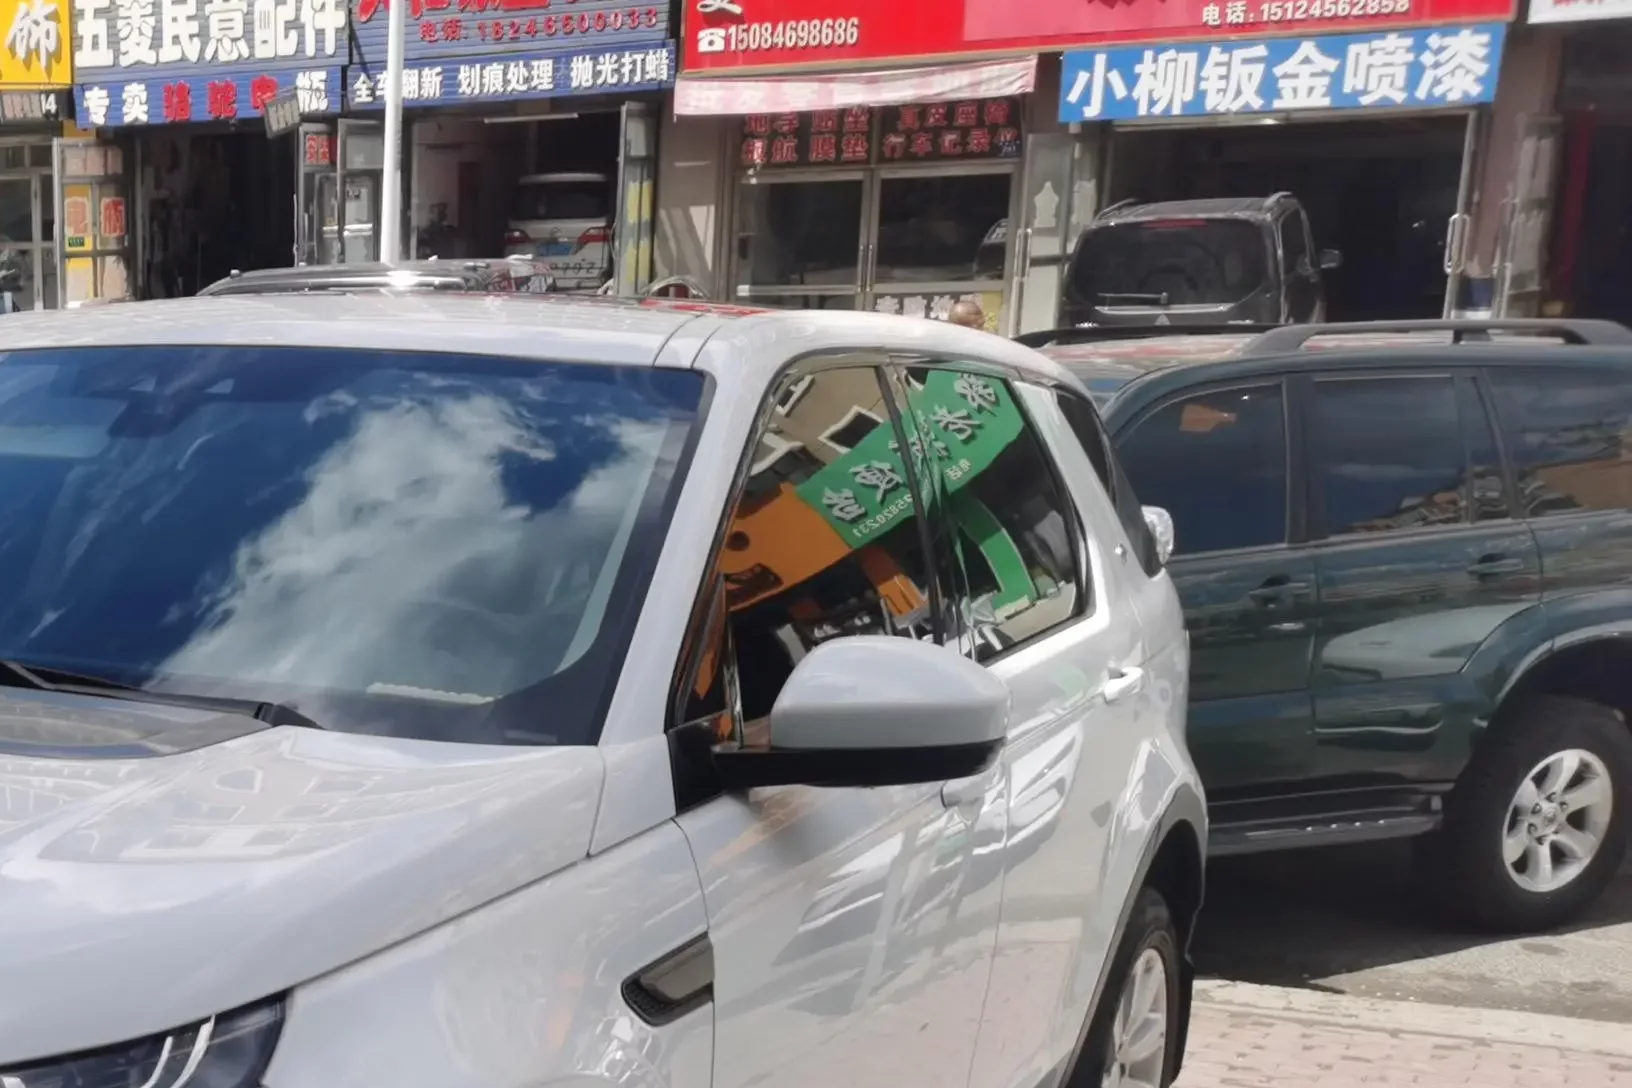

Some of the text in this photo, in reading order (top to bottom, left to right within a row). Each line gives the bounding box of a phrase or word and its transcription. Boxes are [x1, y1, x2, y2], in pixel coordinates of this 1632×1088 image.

[75, 0, 346, 68] 五菱民意配件
[727, 18, 859, 50] 15084698686
[457, 59, 555, 95] 划痕处理
[570, 48, 670, 88] 抛光打蜡
[1067, 30, 1491, 118] 小柳钣金喷漆
